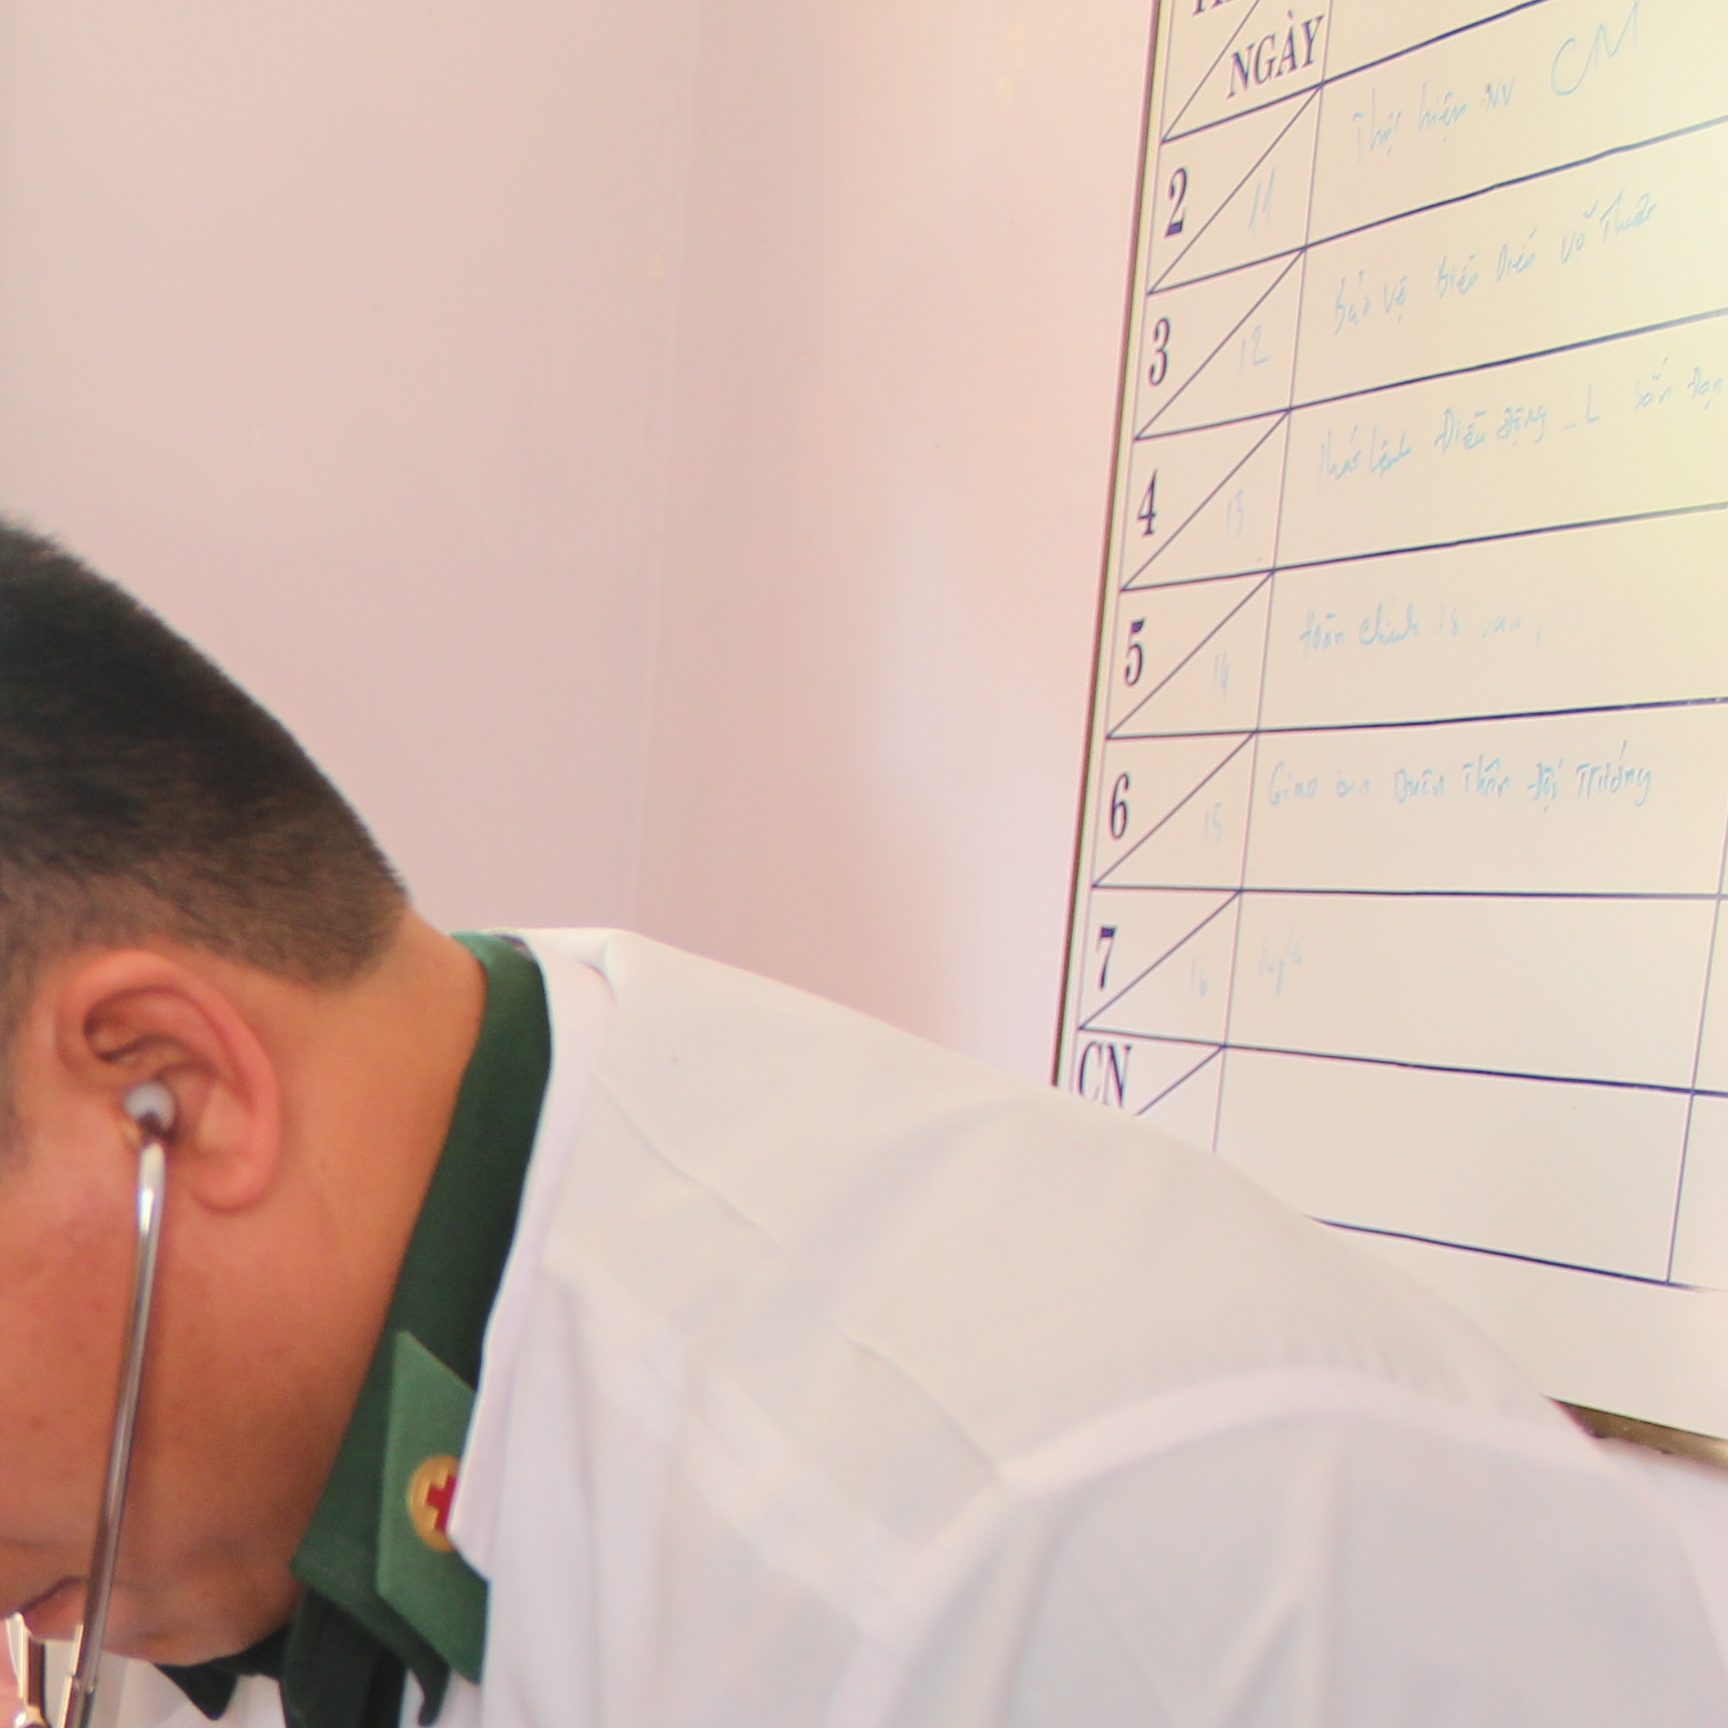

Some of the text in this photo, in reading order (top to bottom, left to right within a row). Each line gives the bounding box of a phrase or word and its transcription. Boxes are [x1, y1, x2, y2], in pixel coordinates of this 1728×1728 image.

[1225, 8, 1325, 100] NGÀY
[1166, 166, 1189, 238] 2
[1148, 317, 1171, 388] 3
[1137, 468, 1158, 537] 4
[1124, 618, 1145, 687] 5
[1110, 772, 1131, 839] 6
[1097, 927, 1116, 991] 7
[1078, 1042, 1132, 1110] CN
